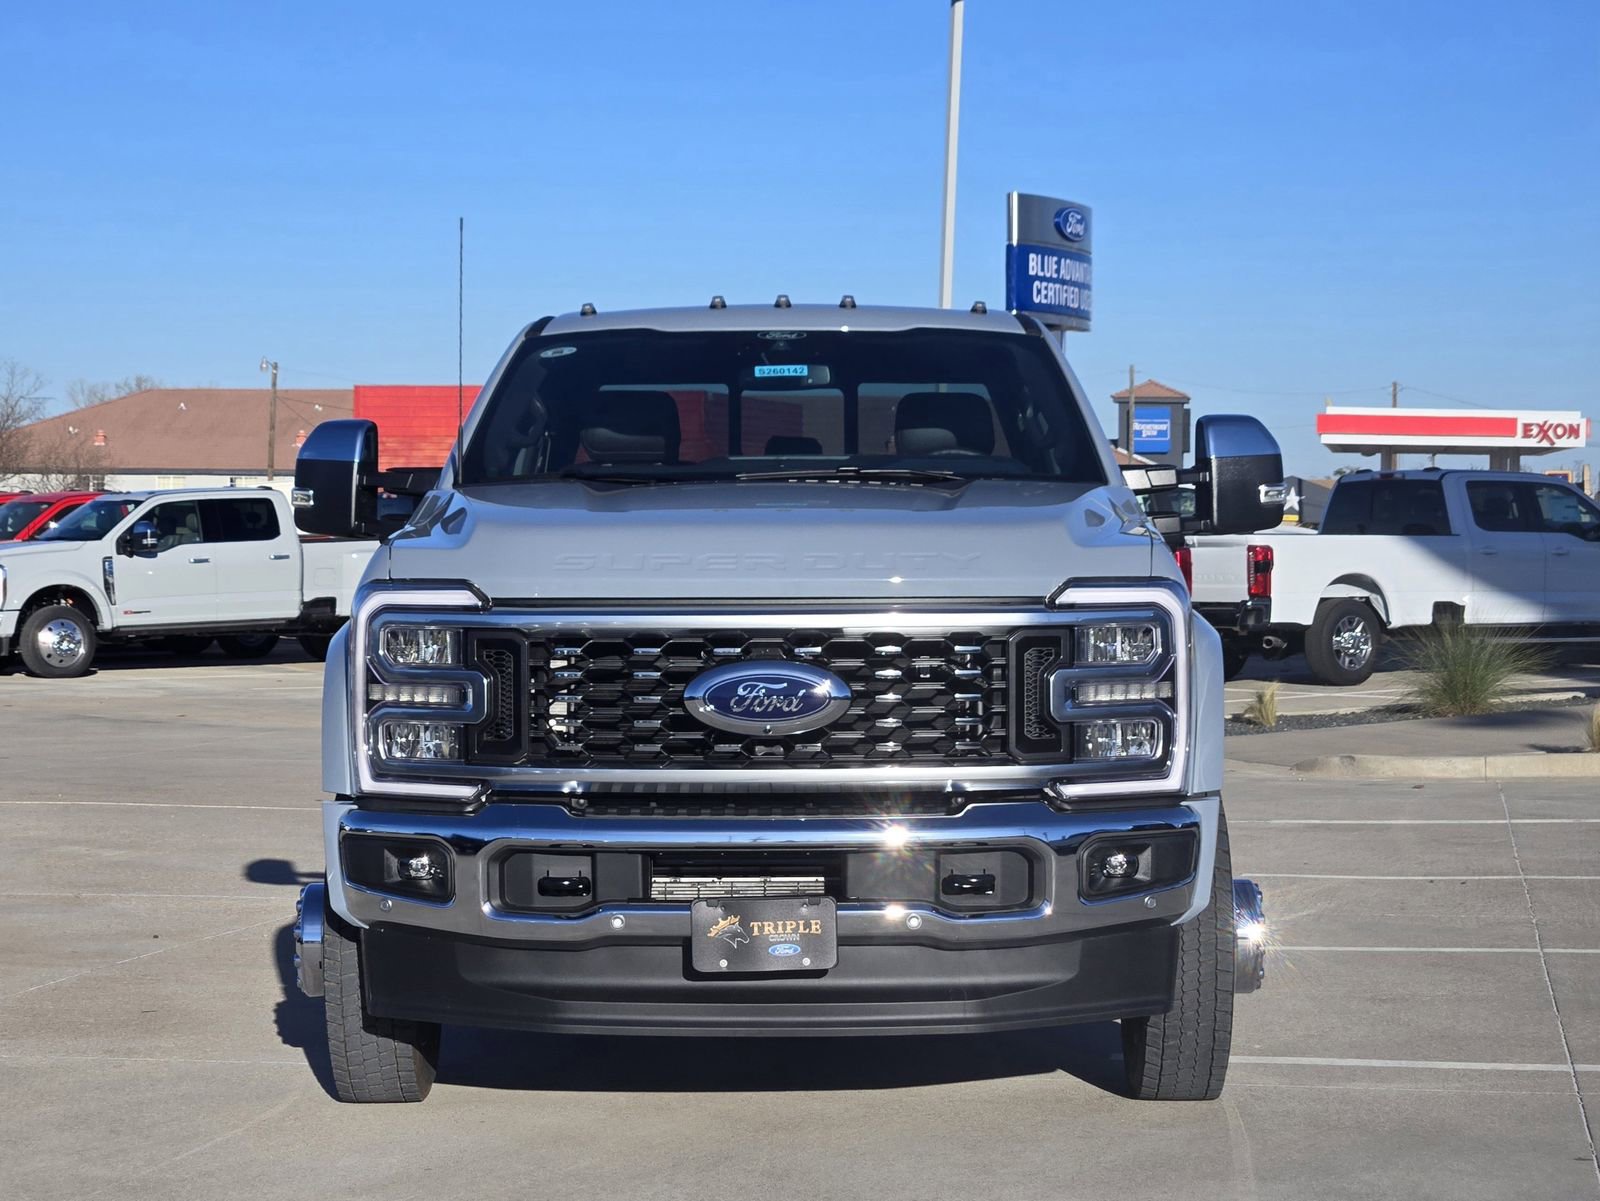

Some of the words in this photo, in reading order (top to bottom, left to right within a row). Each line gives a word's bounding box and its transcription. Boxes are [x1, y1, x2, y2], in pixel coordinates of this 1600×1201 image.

[1066, 212, 1085, 236] Ford
[1028, 253, 1058, 278] BLUE
[1033, 281, 1080, 308] CERTIFIED
[765, 331, 799, 340] Ford
[758, 366, 805, 375] S260142
[1520, 420, 1581, 446] EXXON
[552, 551, 786, 572] SUPER
[803, 551, 982, 572] DUTY
[729, 680, 807, 713] Ford
[749, 919, 822, 936] TRIPLE
[768, 933, 800, 942] CROWN
[774, 944, 795, 955] Ford
